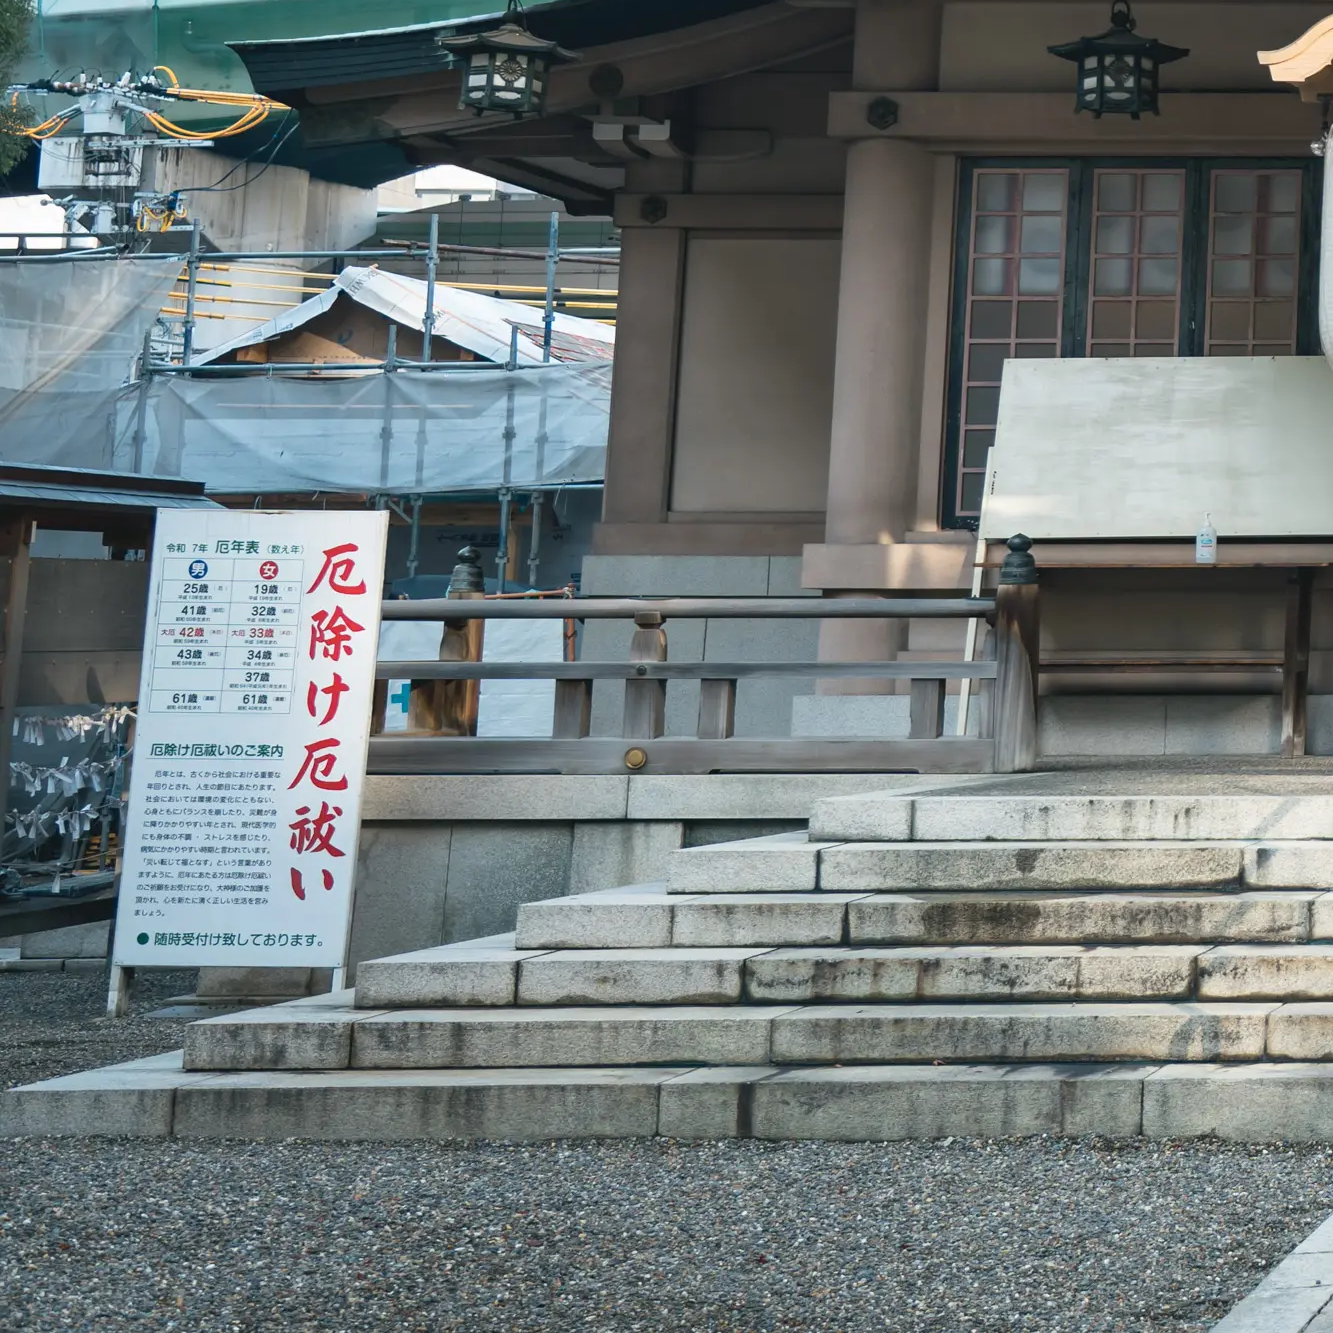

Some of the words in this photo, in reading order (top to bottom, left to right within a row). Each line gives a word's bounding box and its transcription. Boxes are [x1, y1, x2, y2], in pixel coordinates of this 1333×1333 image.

[166, 543, 186, 553] 令和
[192, 544, 208, 553] 7年
[215, 540, 260, 554] 厄年表
[191, 562, 205, 577] 男
[262, 563, 276, 578] 女
[183, 583, 209, 594] 25歳
[254, 584, 278, 595] 19歳
[181, 605, 206, 616] 41歳
[251, 606, 276, 617] 32歳
[179, 627, 205, 638] 42歳
[249, 628, 274, 639] 33歳
[177, 649, 202, 660] 43歳
[247, 650, 272, 661] 34歳
[245, 672, 270, 683] 37歳
[172, 693, 198, 704] 61歳
[243, 694, 268, 705] 61歳
[287, 543, 366, 902] 厄除け厄祓い
[150, 743, 284, 758] 厄除け厄祓いのご案内
[155, 770, 281, 779] 厄年とは、古くから社会における重要な
[146, 782, 277, 792] 年回りとされ、人生の節目にあたります。
[134, 909, 165, 917] ましょう。
[154, 932, 324, 947] 随時受付け致しております。
